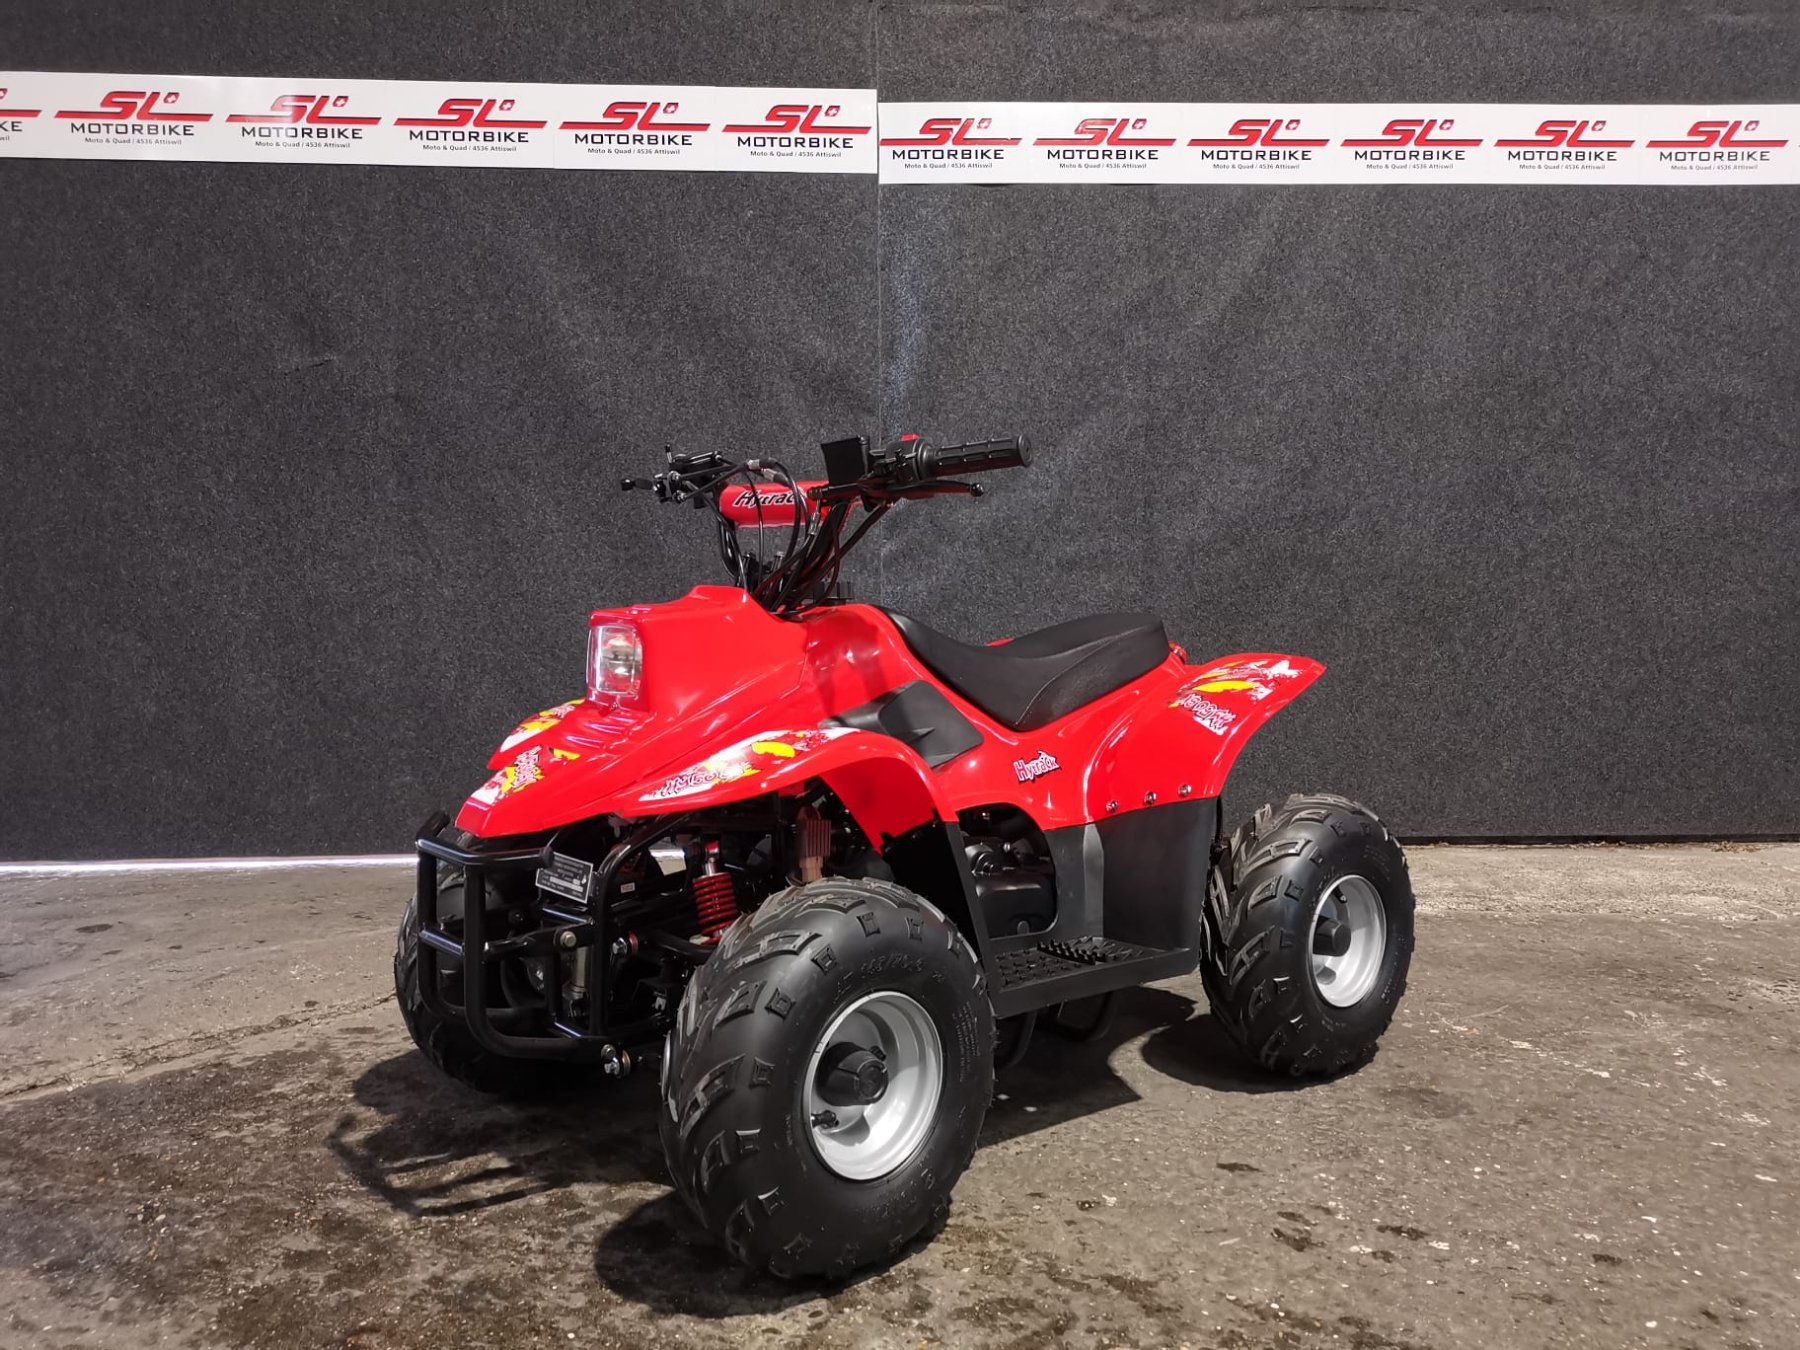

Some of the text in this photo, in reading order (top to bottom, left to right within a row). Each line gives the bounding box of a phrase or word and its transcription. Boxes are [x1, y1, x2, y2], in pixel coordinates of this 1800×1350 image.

[98, 90, 182, 121] SL
[268, 94, 351, 125] SL
[435, 98, 518, 128] SL
[600, 100, 681, 131] SL
[71, 122, 194, 136] MOTORBIKE
[763, 104, 842, 134] SL
[242, 126, 363, 140] MOTORBIKE
[409, 130, 529, 142] MOTORBIKE
[574, 134, 692, 146] MOTORBIKE
[737, 136, 854, 148] MOTORBIKE
[917, 117, 992, 146] SL
[1073, 117, 1148, 147] SL
[1227, 118, 1302, 147] SL
[1380, 118, 1456, 147] SL
[1533, 119, 1608, 148] SL
[1685, 120, 1761, 148] SL
[892, 148, 1004, 160] MOTORBIKE
[1047, 150, 1159, 160] MOTORBIKE
[1201, 150, 1312, 160] MOTORBIKE
[1354, 150, 1466, 160] MOTORBIKE
[1508, 150, 1617, 162] MOTORBIKE
[1659, 150, 1770, 162] MOTORBIKE
